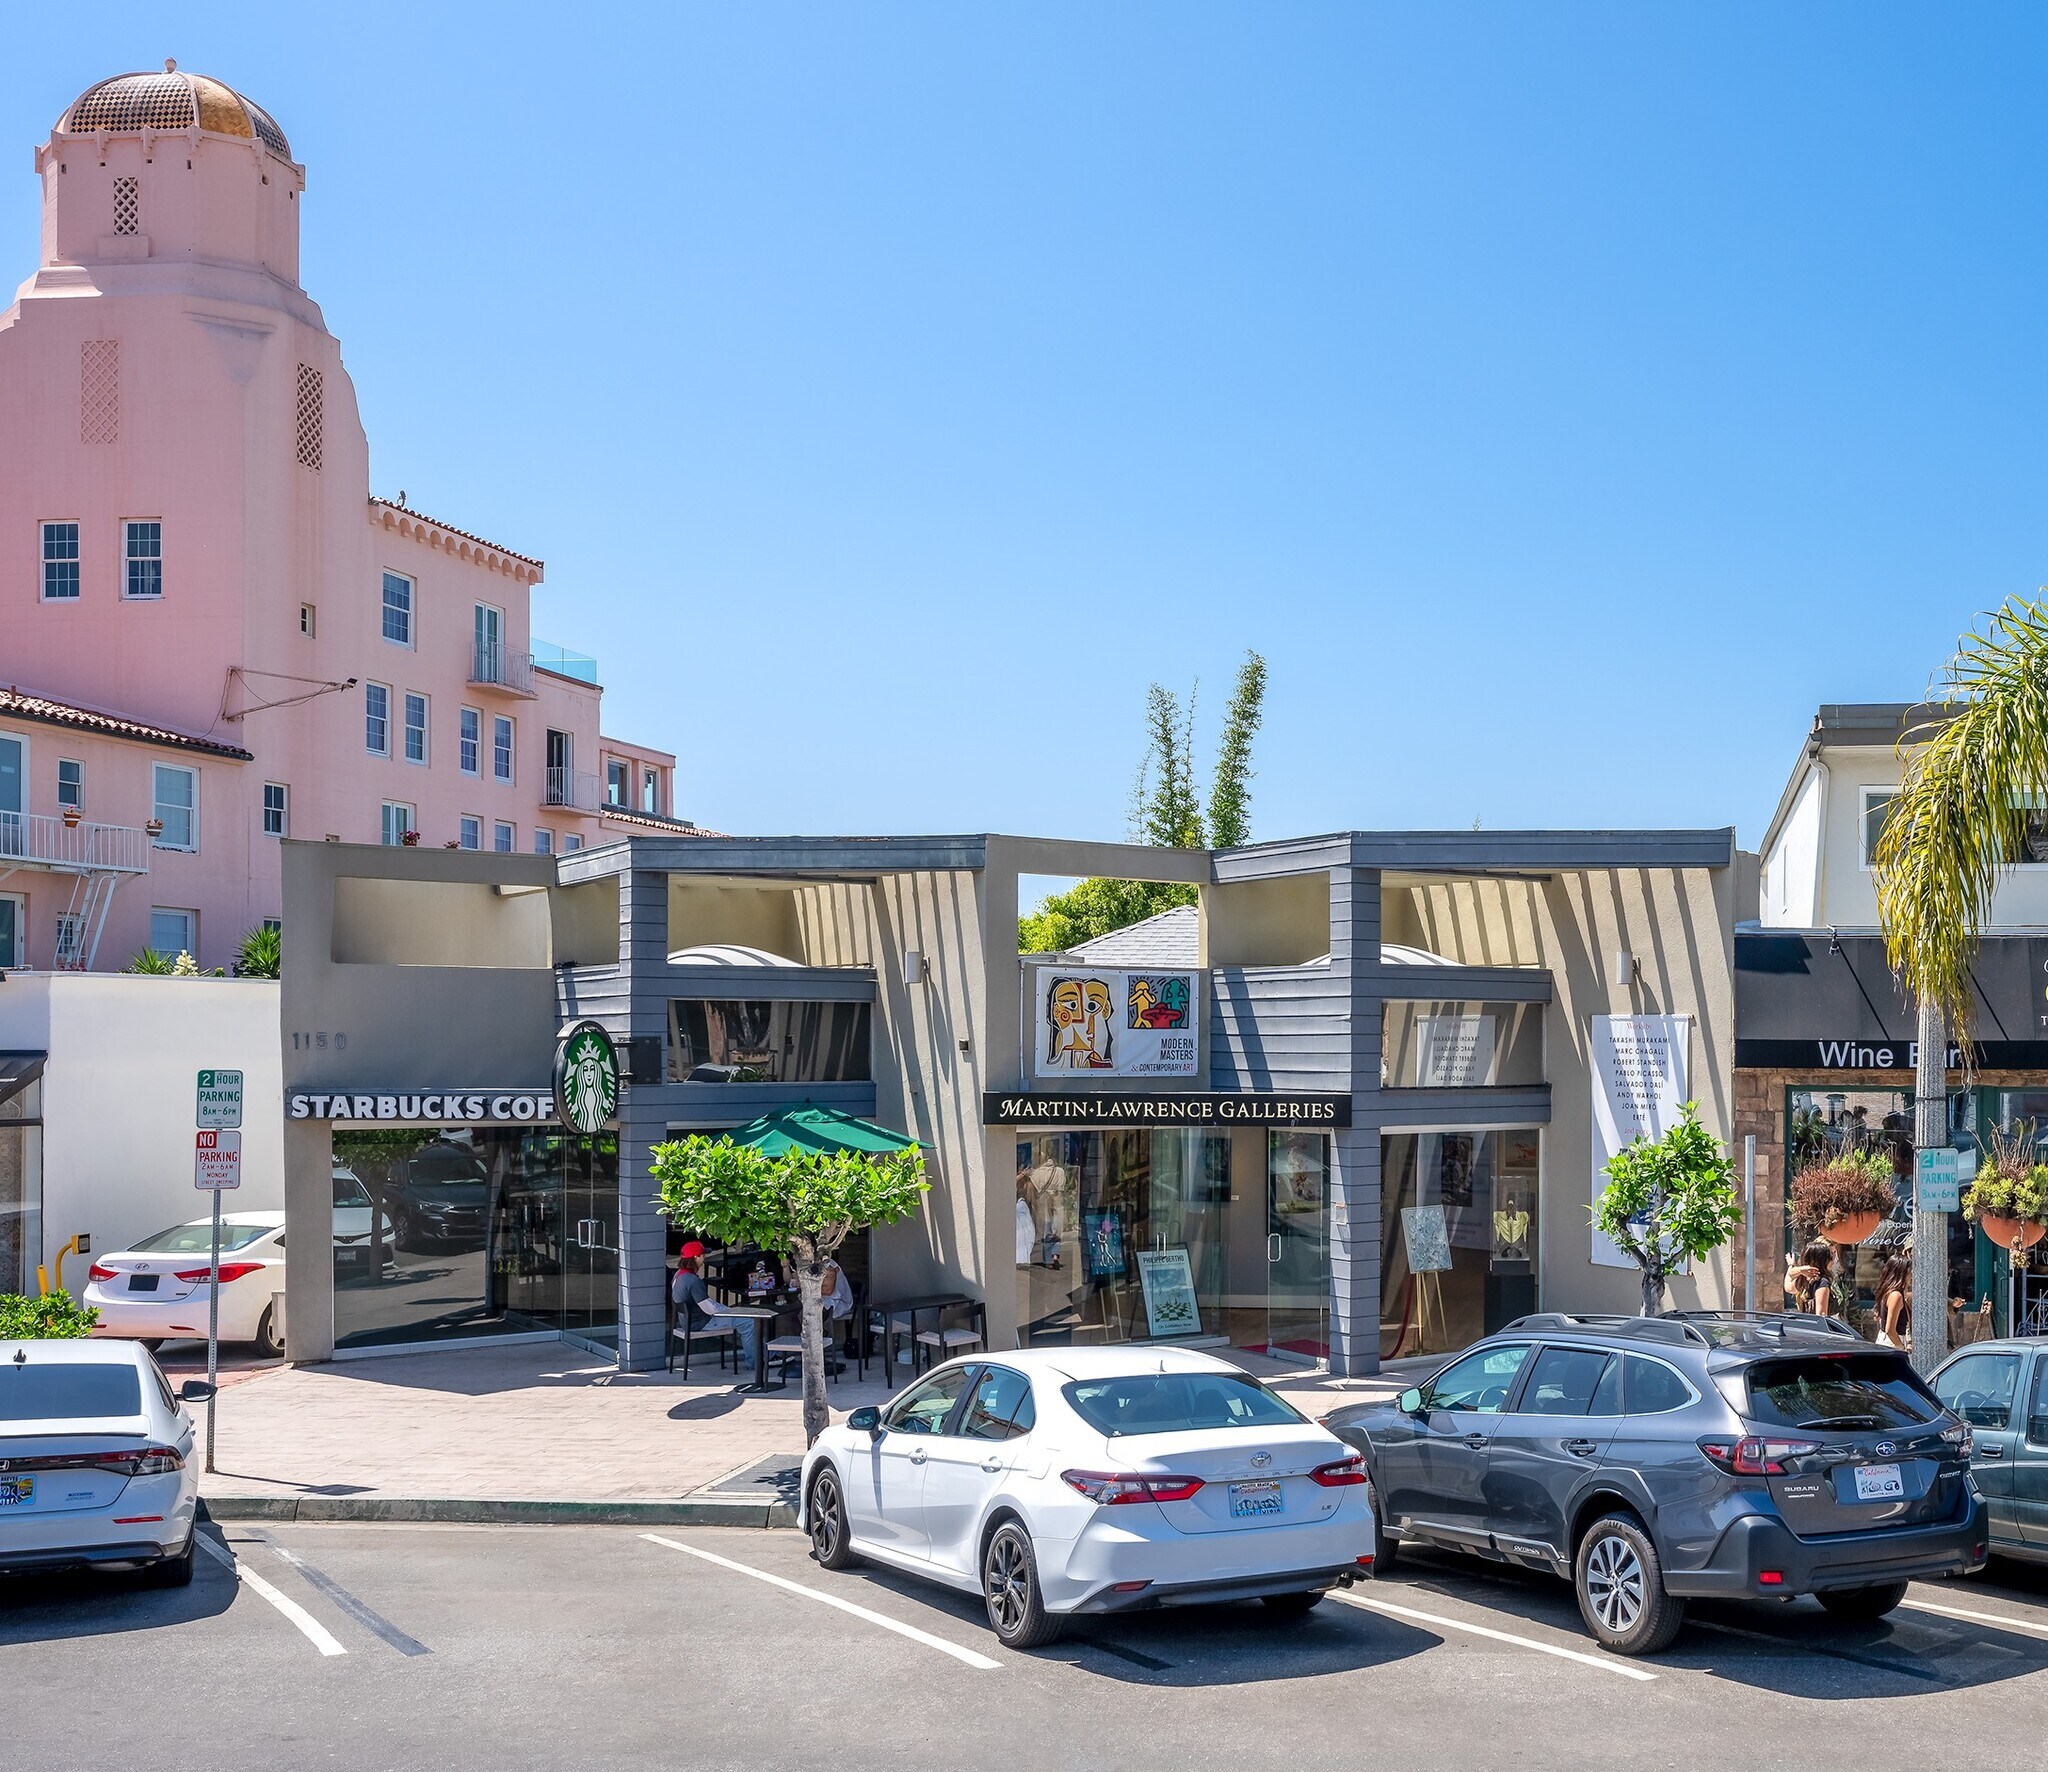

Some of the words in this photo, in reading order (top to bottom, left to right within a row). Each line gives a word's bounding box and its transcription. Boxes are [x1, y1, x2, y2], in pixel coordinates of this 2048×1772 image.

[292, 1032, 347, 1050] 1150
[1161, 1038, 1194, 1049] MODERN
[1160, 1050, 1194, 1060] MASTERS
[1818, 1041, 1894, 1068] Wine
[1139, 1063, 1182, 1071] CONTEMPORARY
[1183, 1063, 1193, 1071] ART
[202, 1073, 211, 1086] 2
[216, 1074, 239, 1084] HOUR
[200, 1091, 240, 1102] PARKING
[291, 1095, 484, 1120] STARBUCKS
[491, 1096, 554, 1120] COF
[1219, 1100, 1335, 1119] GALLERIES
[200, 1133, 215, 1147] NO
[199, 1151, 238, 1162] PARKING
[1922, 1153, 1931, 1166] 2
[1935, 1155, 1956, 1165] HOUR
[1921, 1172, 1956, 1184] PARKING
[1887, 1221, 1912, 1229] Experi
